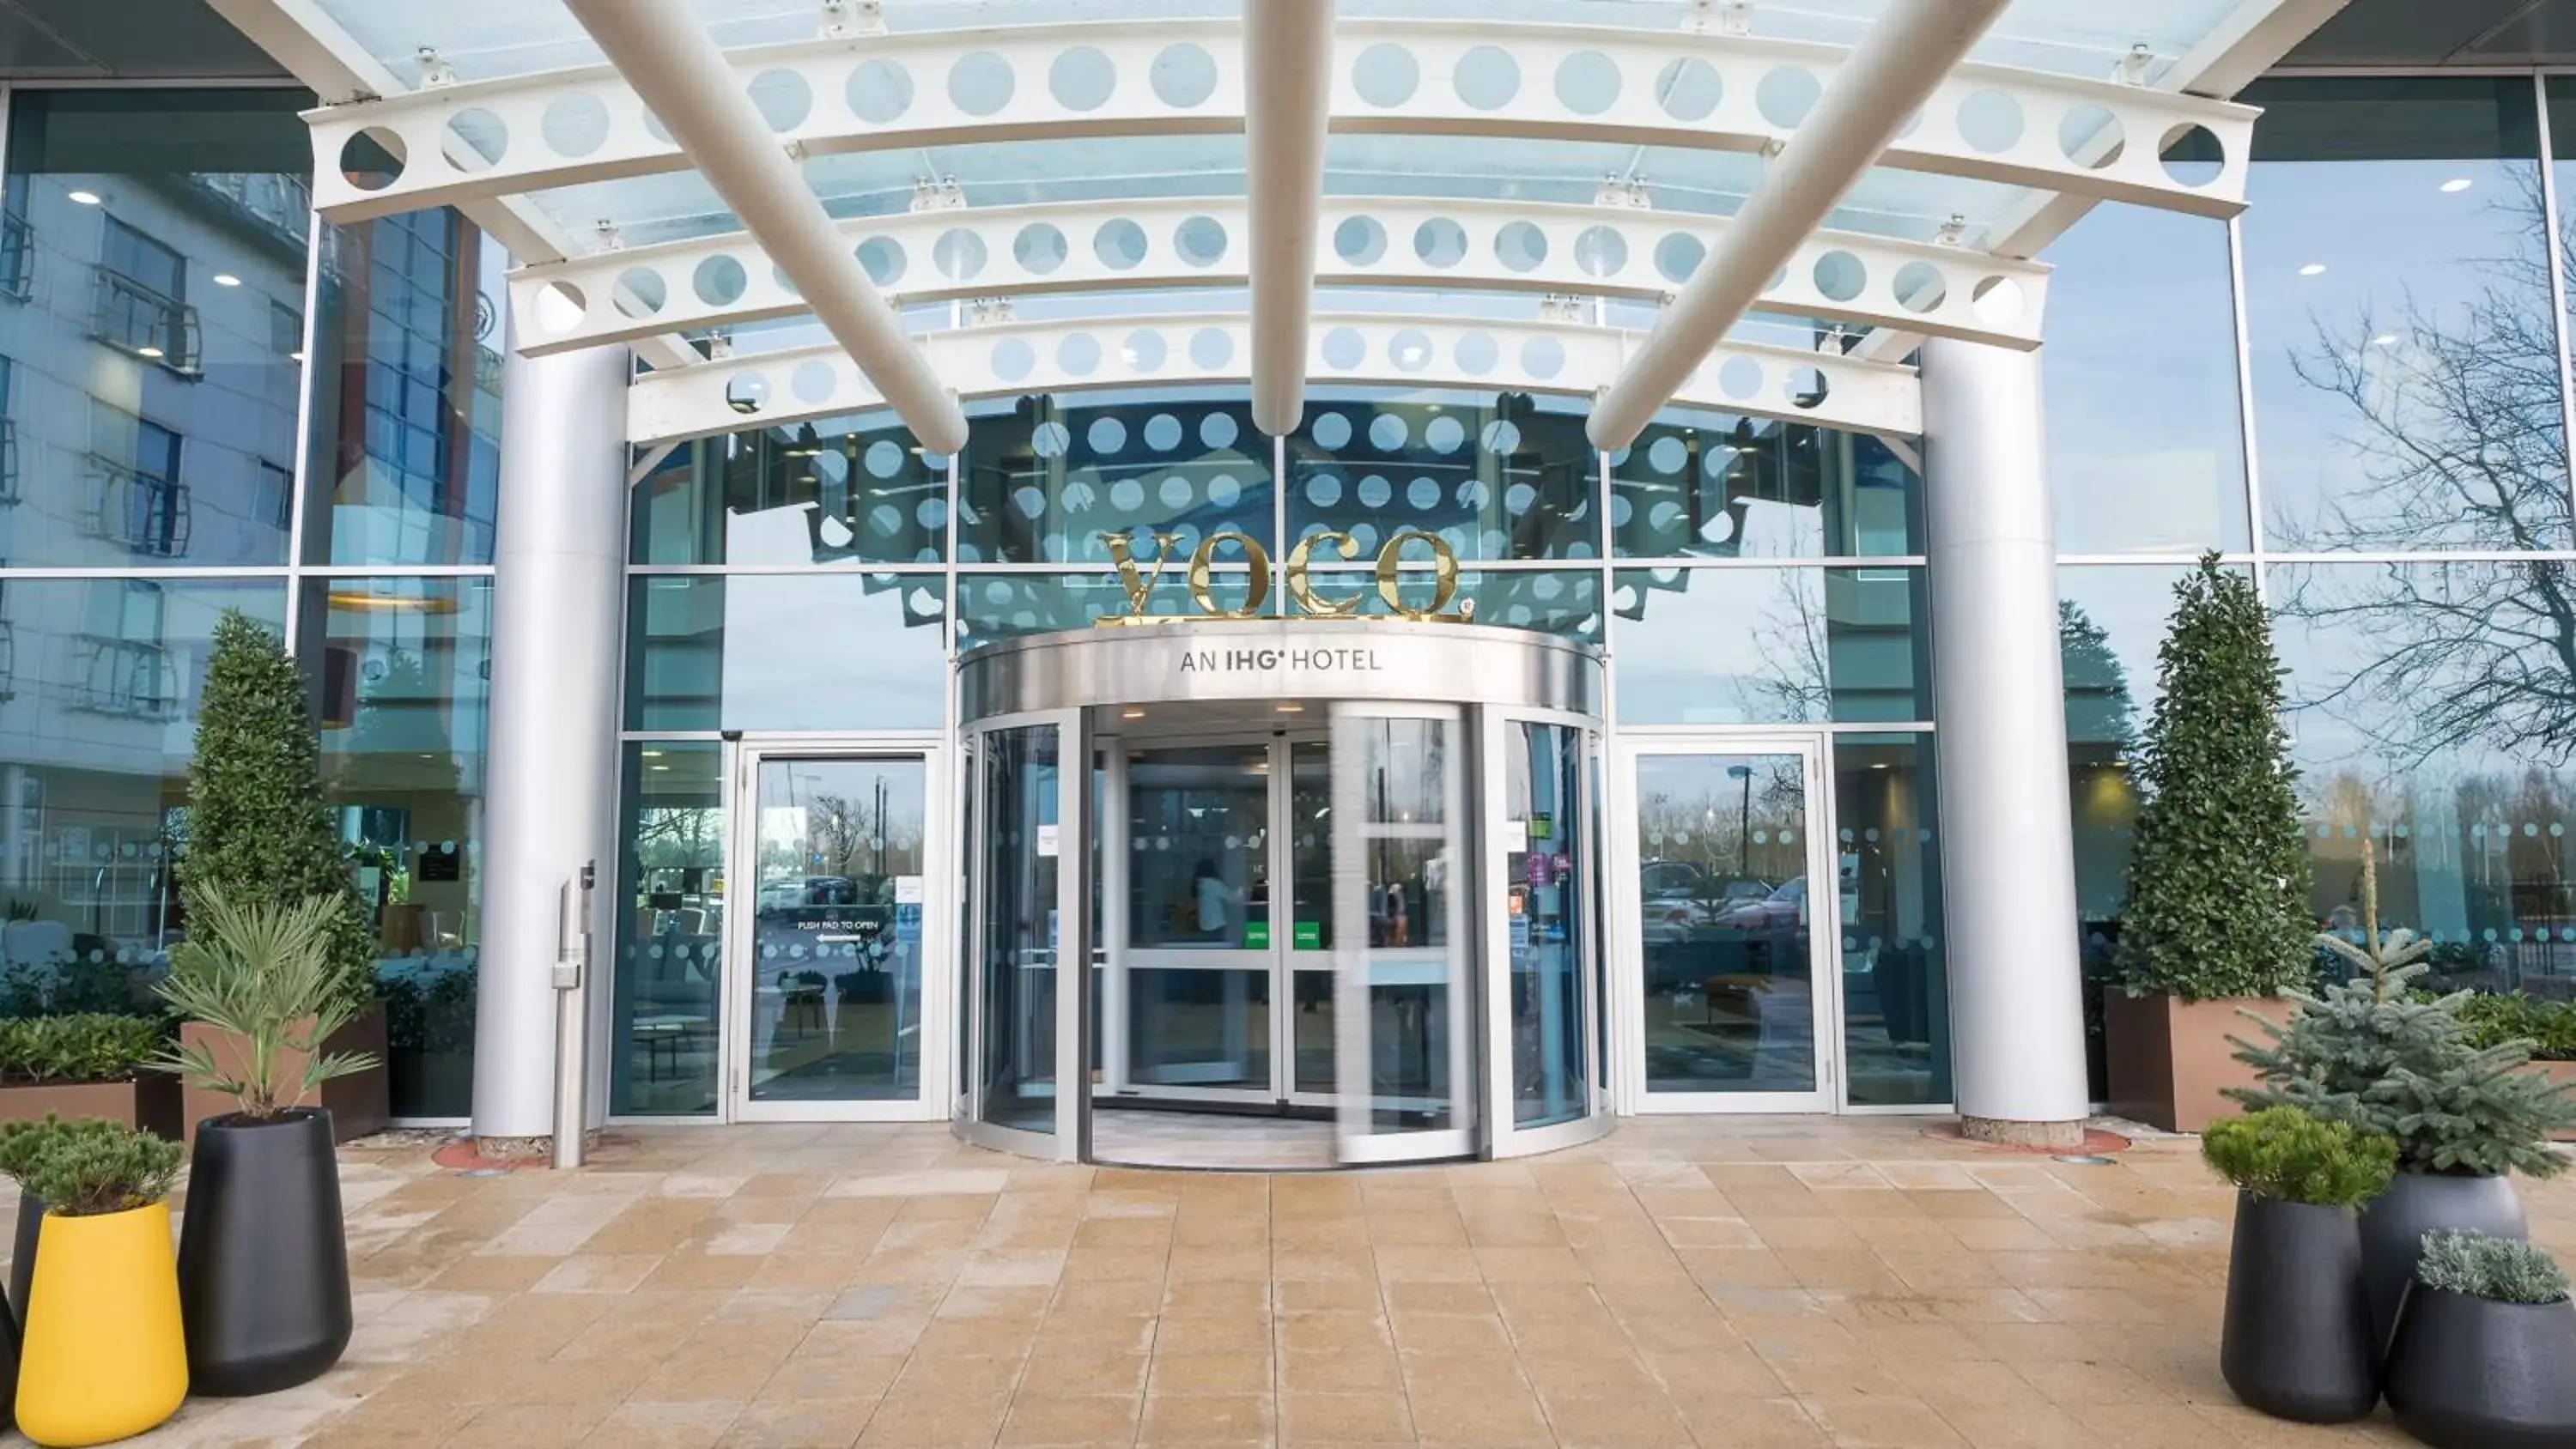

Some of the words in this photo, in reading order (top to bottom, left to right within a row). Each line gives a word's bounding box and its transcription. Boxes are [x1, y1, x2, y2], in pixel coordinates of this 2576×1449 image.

[1181, 651, 1217, 671] AN
[1291, 649, 1382, 670] HOTEL
[798, 921, 820, 931] PUSH
[822, 921, 840, 931] PAD
[841, 921, 854, 930] TO
[855, 920, 878, 930] OPEN
